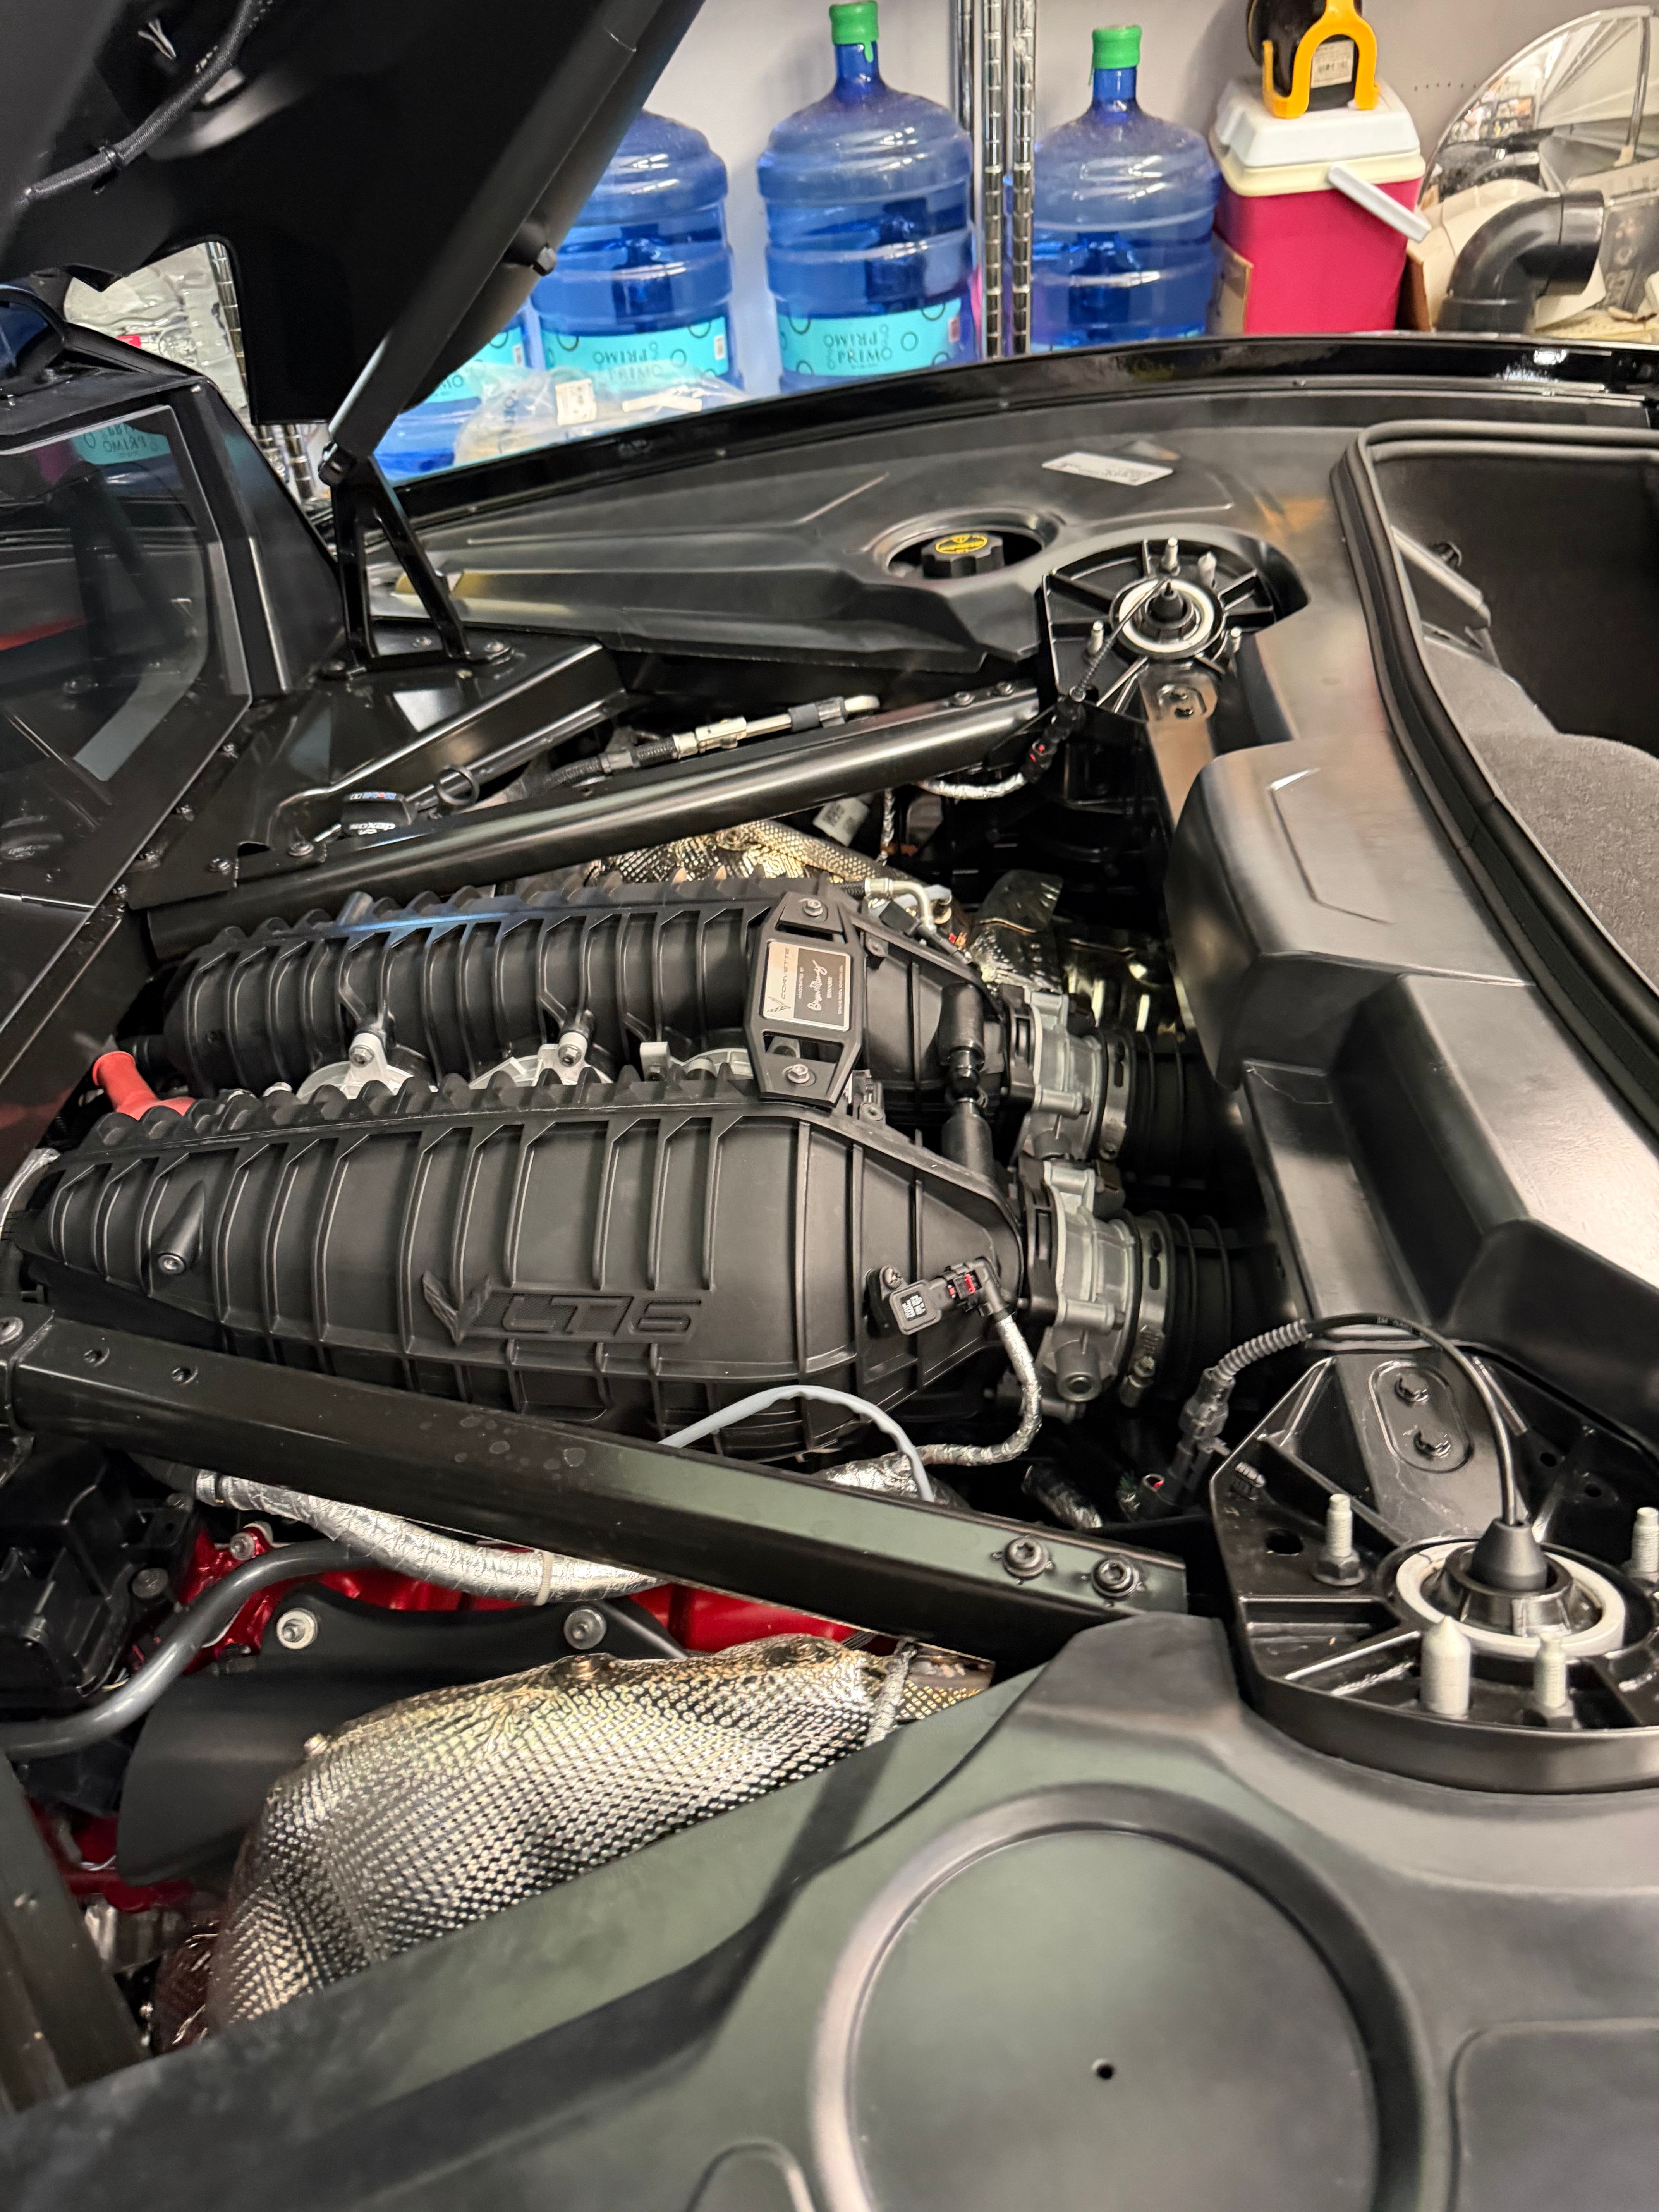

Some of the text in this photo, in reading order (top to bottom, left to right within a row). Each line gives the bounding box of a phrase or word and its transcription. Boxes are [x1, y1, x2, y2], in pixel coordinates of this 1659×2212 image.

[823, 331, 878, 348] PRIMO
[592, 349, 647, 364] PRIMO
[838, 347, 893, 364] PRIMO
[349, 822, 396, 831] dexos
[781, 948, 790, 1000] CORVETTE
[502, 1293, 702, 1338] LT6
